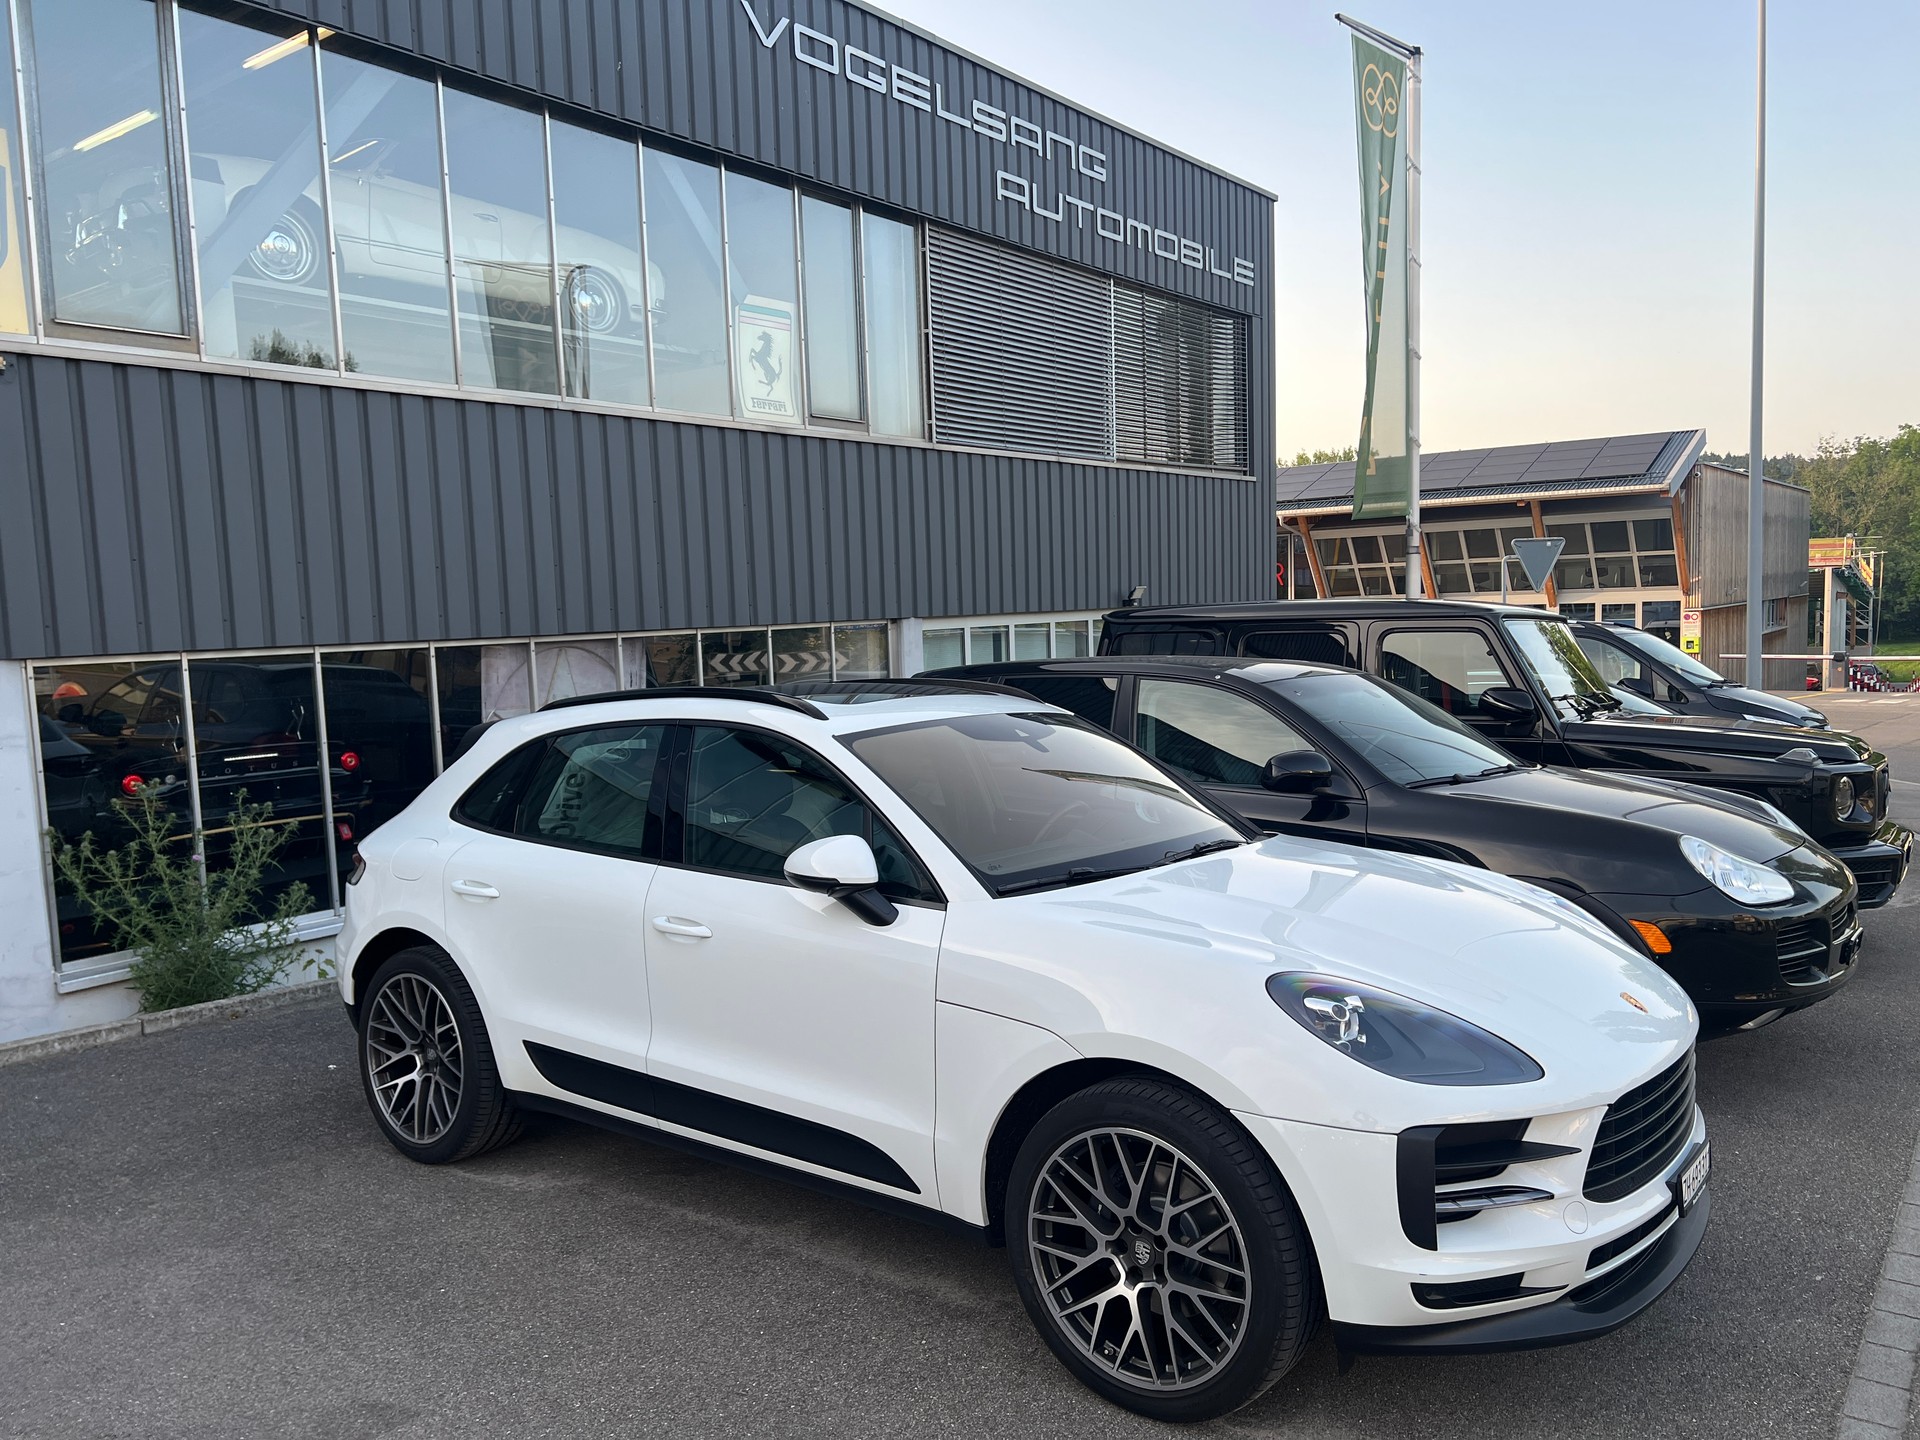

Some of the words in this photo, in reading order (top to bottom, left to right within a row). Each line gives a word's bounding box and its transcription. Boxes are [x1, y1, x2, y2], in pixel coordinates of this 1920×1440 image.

[741, 0, 1107, 183] VOGELSANG
[996, 169, 1255, 287] AUTOMOBILE
[751, 397, 788, 412] Ferrari
[201, 760, 298, 776] LOTUS
